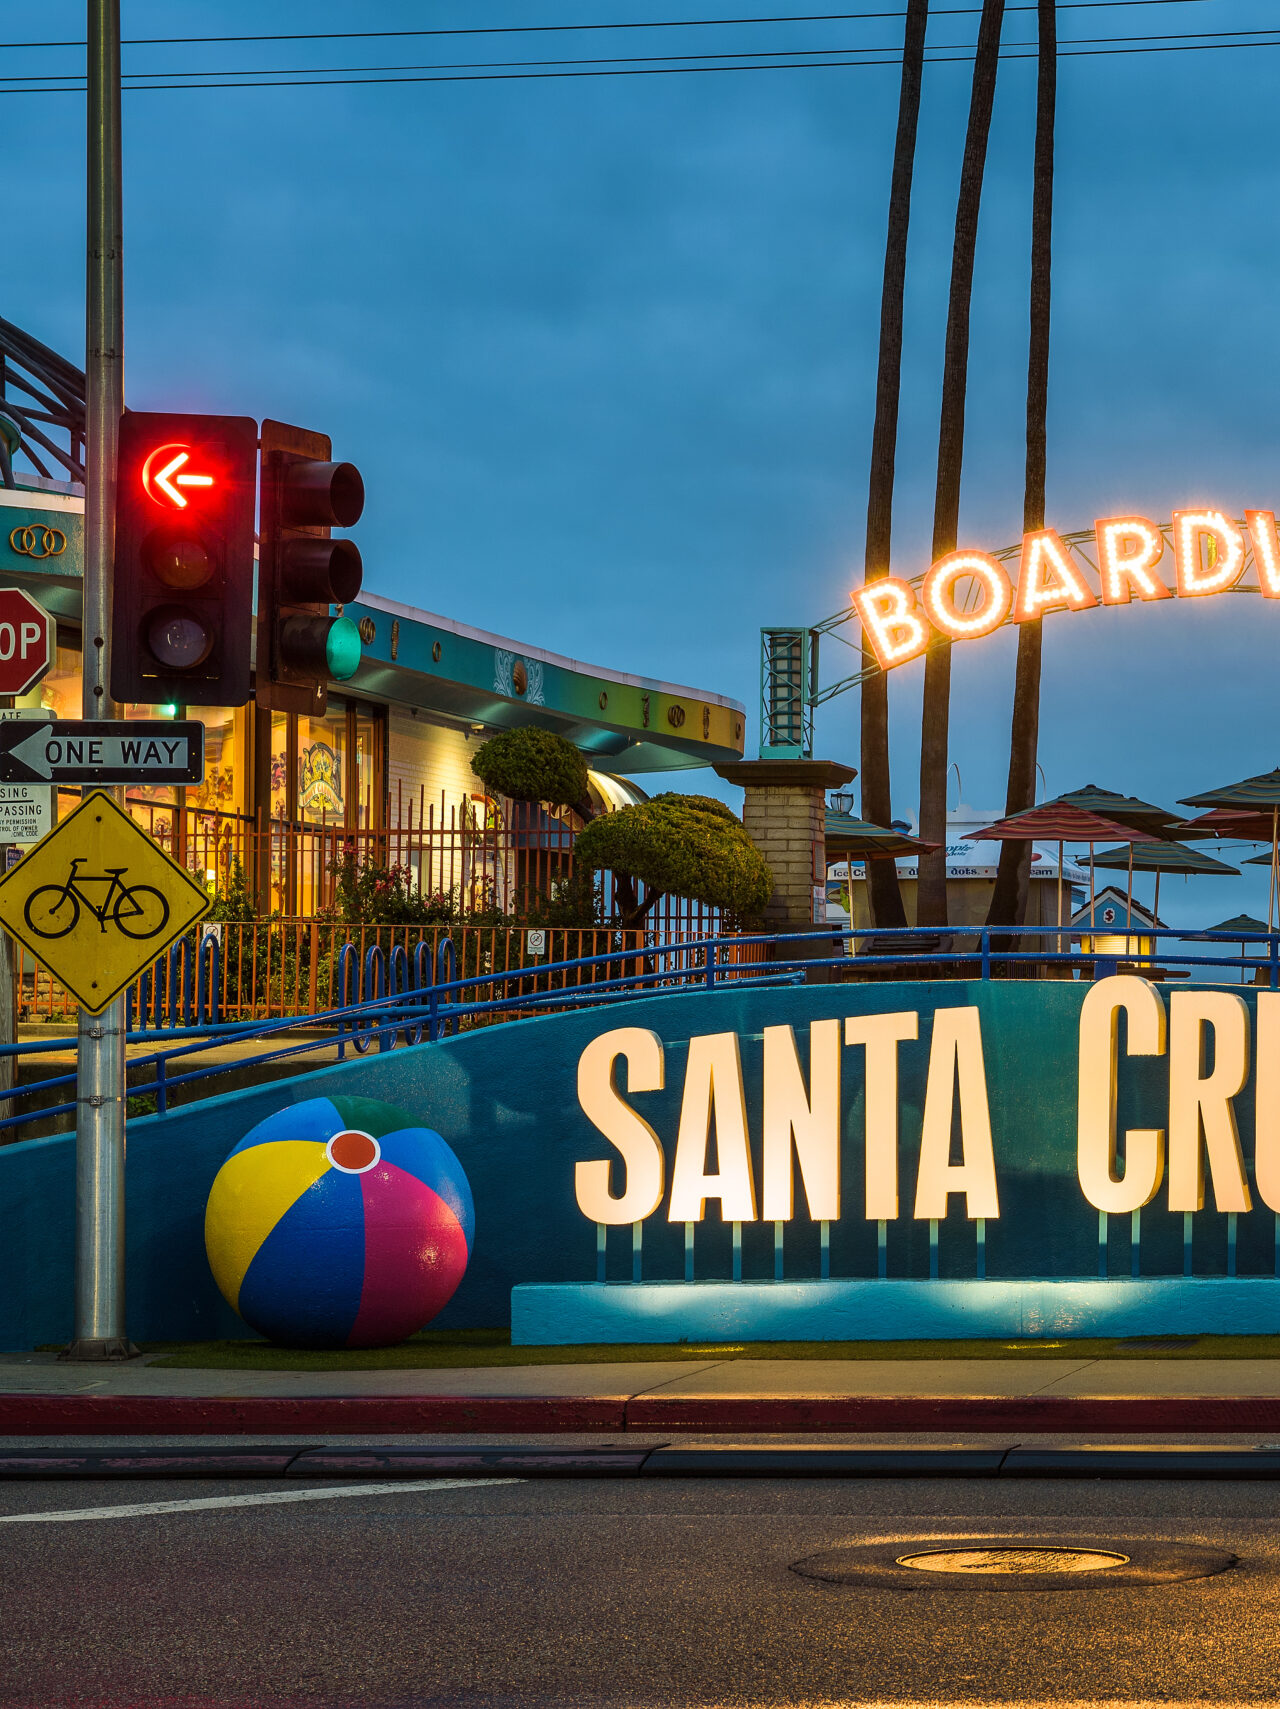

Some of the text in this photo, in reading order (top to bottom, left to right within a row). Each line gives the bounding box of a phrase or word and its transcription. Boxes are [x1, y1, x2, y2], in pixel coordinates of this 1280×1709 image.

[45, 741, 181, 764] ONE WAY
[574, 1005, 1000, 1225] SANTA
